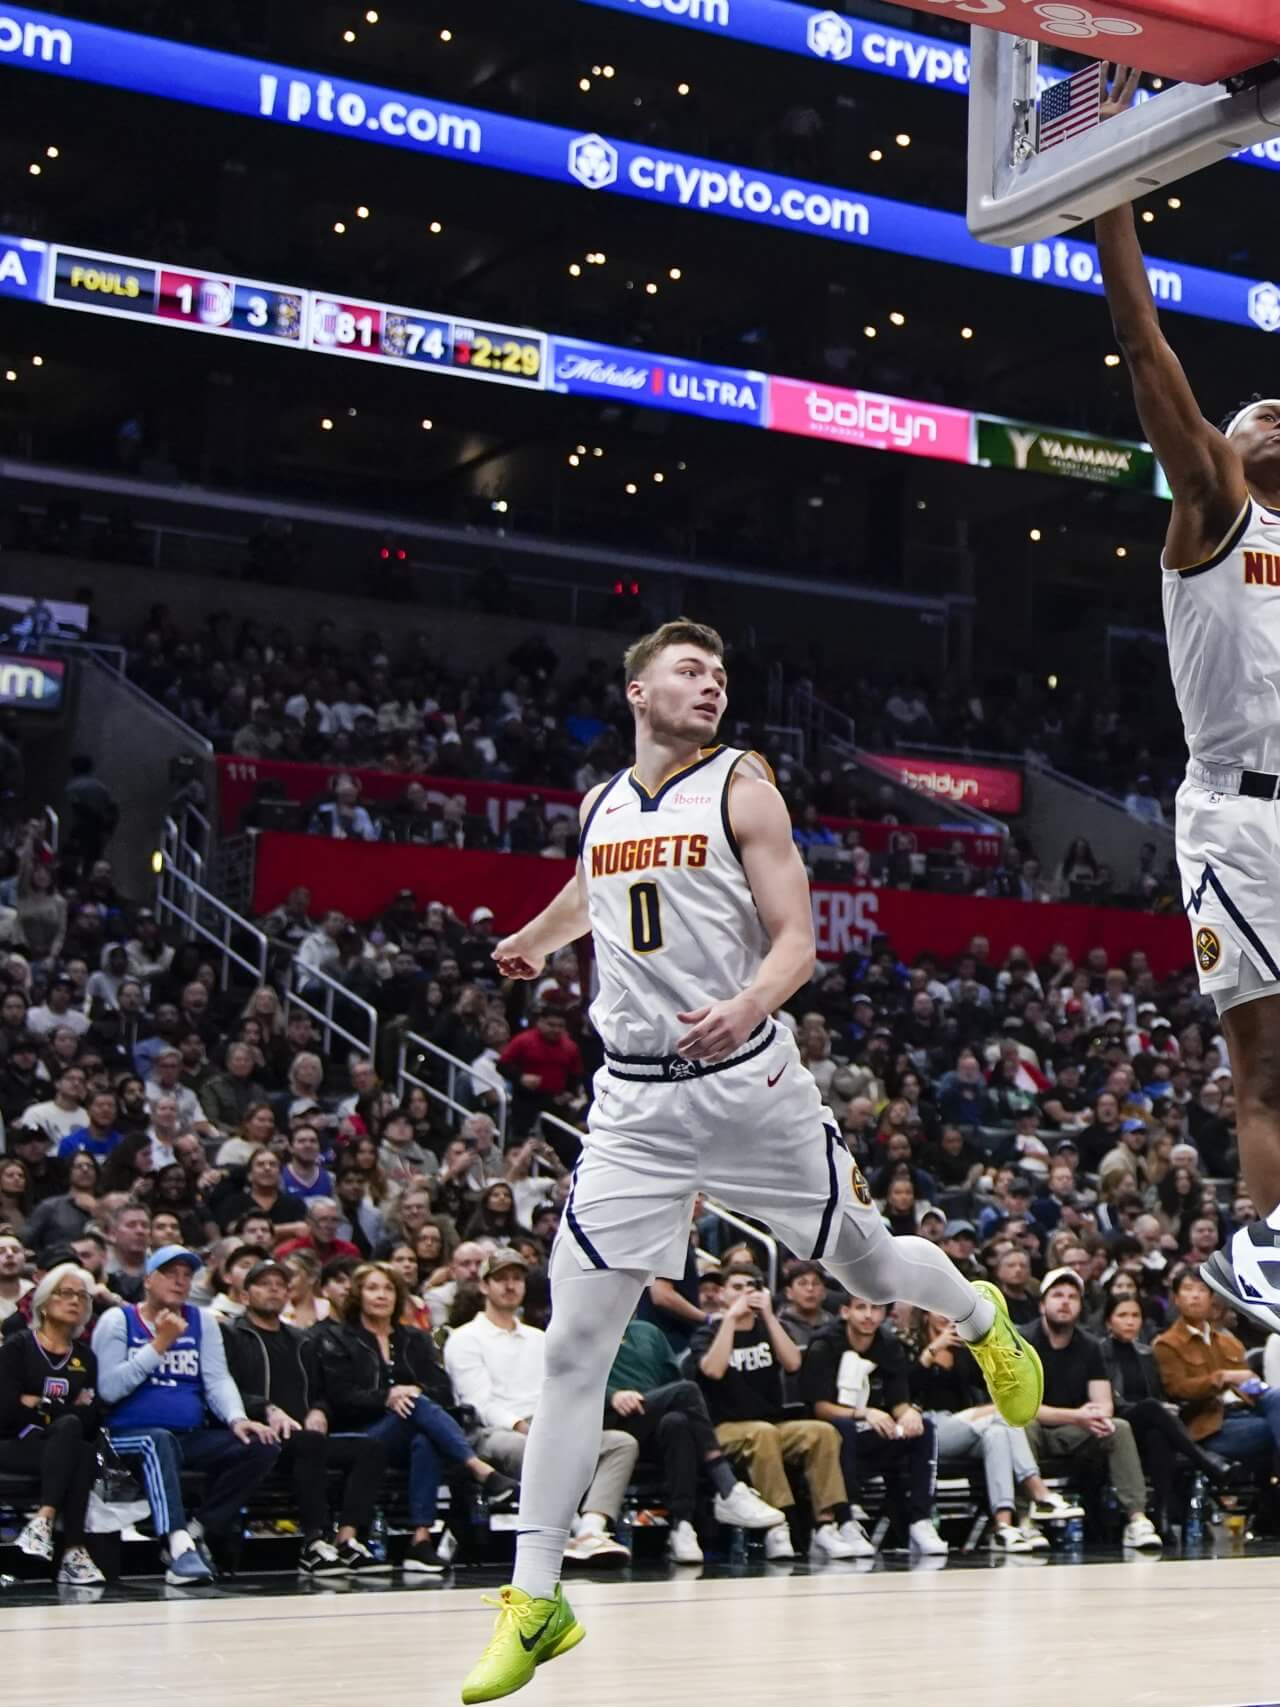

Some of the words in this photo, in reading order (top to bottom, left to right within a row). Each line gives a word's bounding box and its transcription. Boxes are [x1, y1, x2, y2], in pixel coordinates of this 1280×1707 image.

[862, 34, 970, 84] crypt
[628, 155, 869, 236] crypto.com
[71, 266, 139, 298] FOULS
[176, 284, 193, 314] 1
[247, 296, 268, 327] 3
[336, 312, 373, 347] 81
[406, 324, 445, 359] 74
[471, 336, 540, 375] 2:29
[557, 354, 649, 389] Michelob
[668, 373, 757, 410] ULTRA
[805, 390, 936, 446] boldyn
[592, 834, 708, 877] NUGGETS
[629, 879, 664, 955] 0
